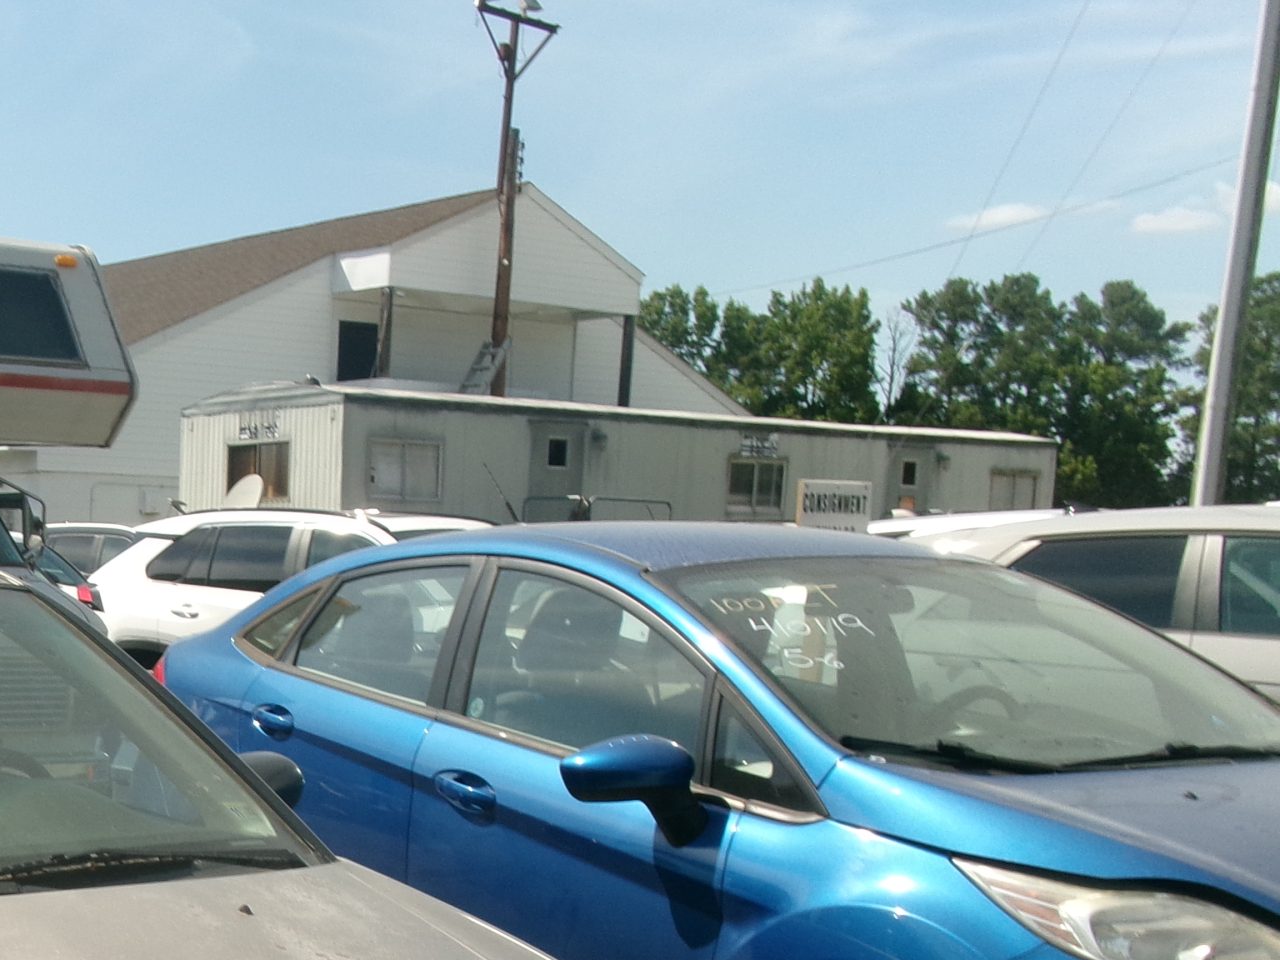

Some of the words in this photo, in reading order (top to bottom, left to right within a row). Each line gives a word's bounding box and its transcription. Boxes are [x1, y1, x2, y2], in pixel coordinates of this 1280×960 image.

[802, 490, 867, 514] CONSIGNMENT
[748, 613, 876, 637] 410119
[783, 647, 845, 669] 5-6
